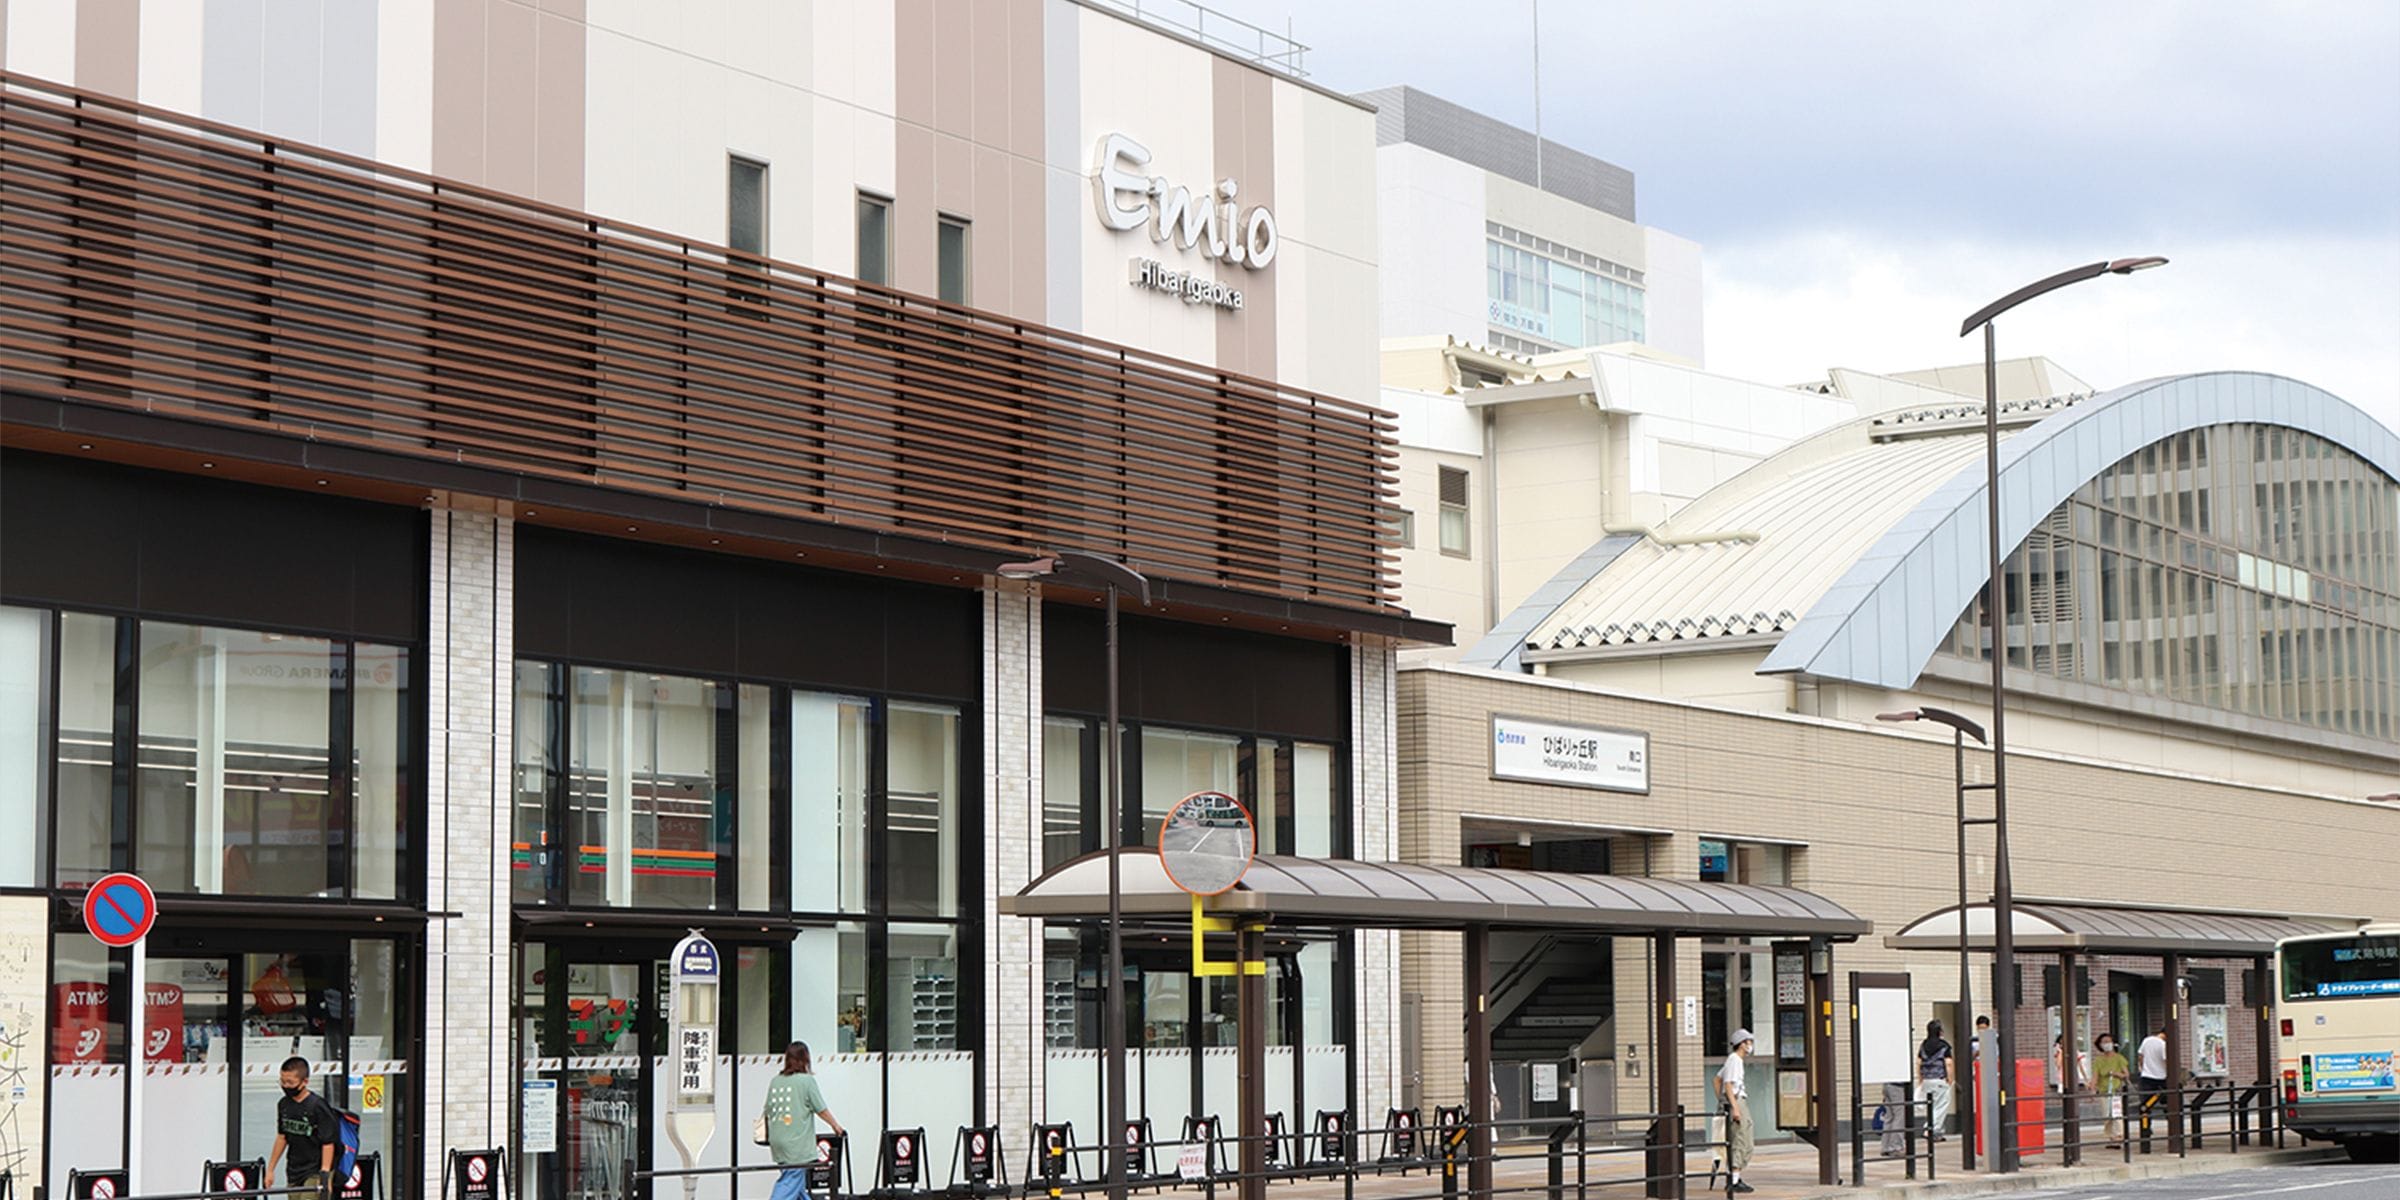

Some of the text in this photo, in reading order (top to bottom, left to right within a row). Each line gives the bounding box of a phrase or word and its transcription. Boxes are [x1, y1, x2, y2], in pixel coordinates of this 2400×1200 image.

[1091, 133, 1278, 270] Emio
[1131, 257, 1244, 310] Hibarigaoka
[683, 1031, 701, 1089] 降車専用
